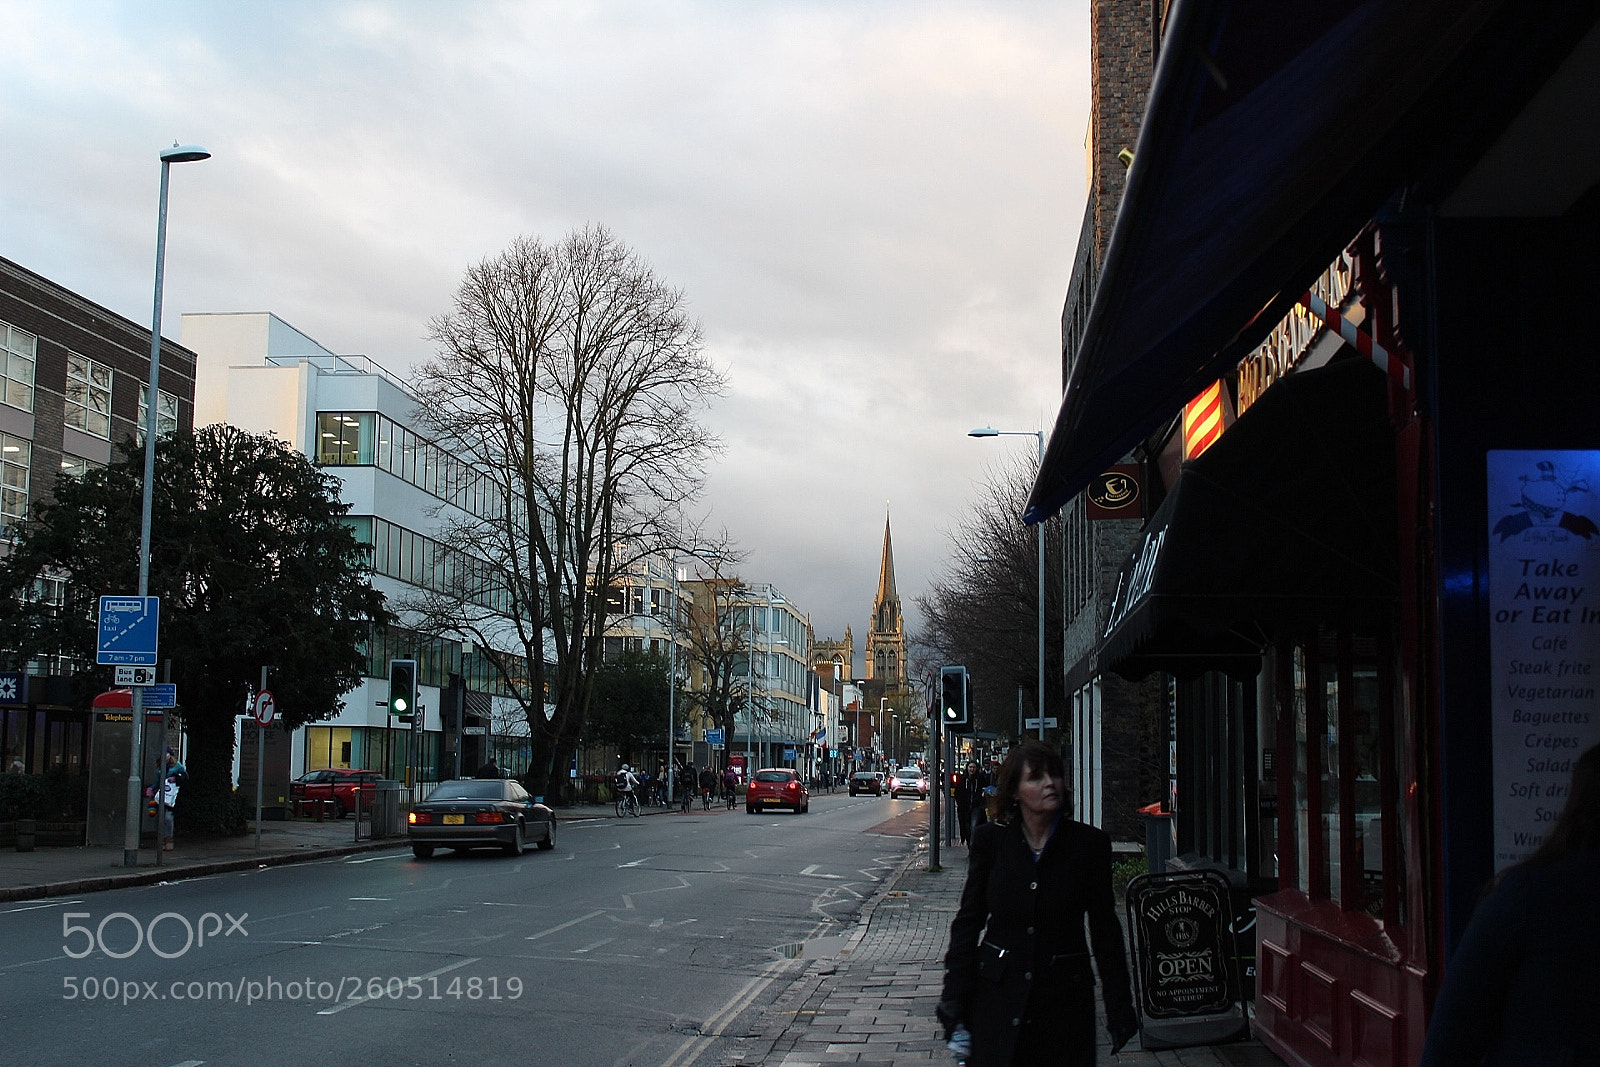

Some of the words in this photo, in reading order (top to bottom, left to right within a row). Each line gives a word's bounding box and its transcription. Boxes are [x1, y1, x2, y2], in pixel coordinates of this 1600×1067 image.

[1518, 559, 1579, 577] Take
[1513, 582, 1584, 604] Away
[1494, 609, 1523, 624] or
[1531, 605, 1572, 624] Eat
[1532, 635, 1567, 654] Café
[1508, 659, 1552, 675] Steak
[1557, 659, 1592, 677] frite
[117, 675, 132, 683] lane
[1507, 684, 1595, 702] Vegetarian
[1511, 708, 1590, 727] Baguettes
[1509, 782, 1541, 800] Soft
[1545, 782, 1569, 798] dri
[1146, 894, 1178, 922] HILLS
[1178, 890, 1216, 919] BARBER
[1158, 956, 1212, 977] OPEN
[1156, 989, 1167, 997] NO
[1168, 985, 1219, 997] APPOINTMENT
